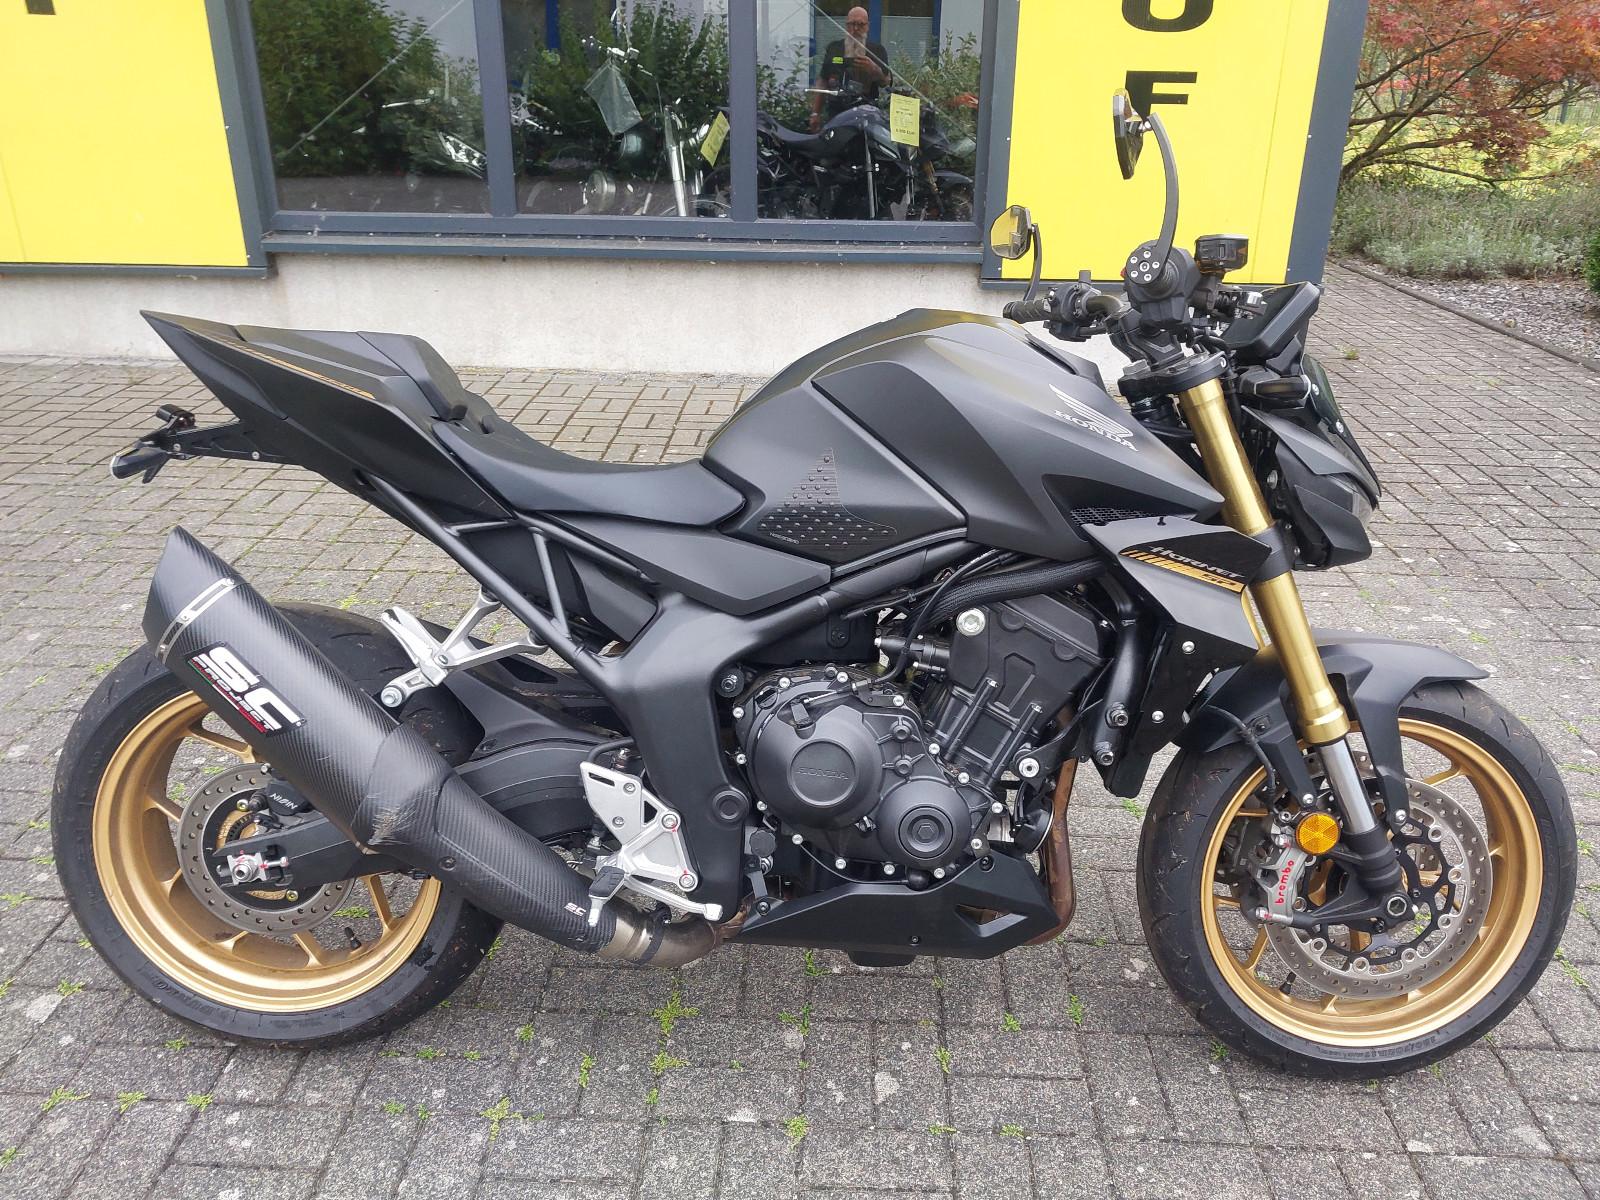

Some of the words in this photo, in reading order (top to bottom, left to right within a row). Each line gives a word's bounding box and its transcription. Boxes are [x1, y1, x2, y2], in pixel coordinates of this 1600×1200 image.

[1054, 409, 1139, 452] HONDA
[1201, 573, 1237, 586] SP
[191, 656, 275, 732] PROJECT
[197, 646, 302, 731] SC
[795, 766, 849, 780] HONDA
[1274, 859, 1295, 905] brembo
[563, 902, 587, 917] SC
